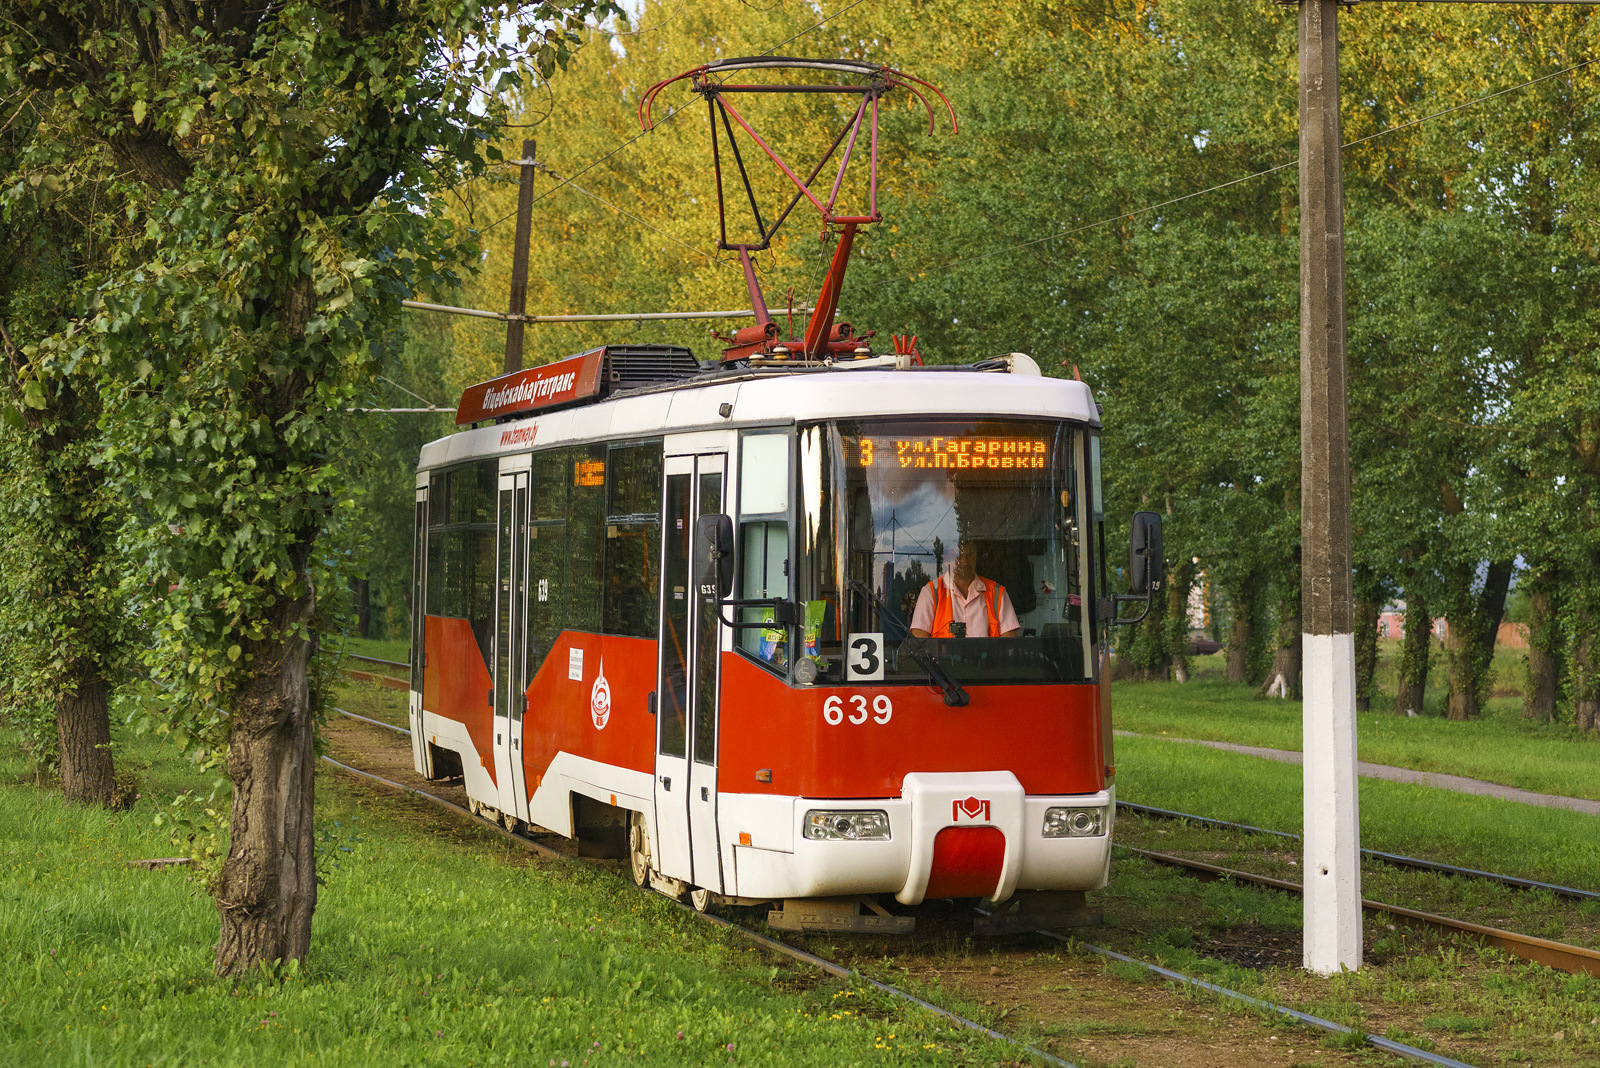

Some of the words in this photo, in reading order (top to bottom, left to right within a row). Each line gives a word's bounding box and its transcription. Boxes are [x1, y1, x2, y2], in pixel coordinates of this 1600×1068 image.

[860, 438, 873, 467] 3
[538, 579, 548, 602] 639
[850, 638, 880, 675] 3
[823, 694, 893, 726] 639
